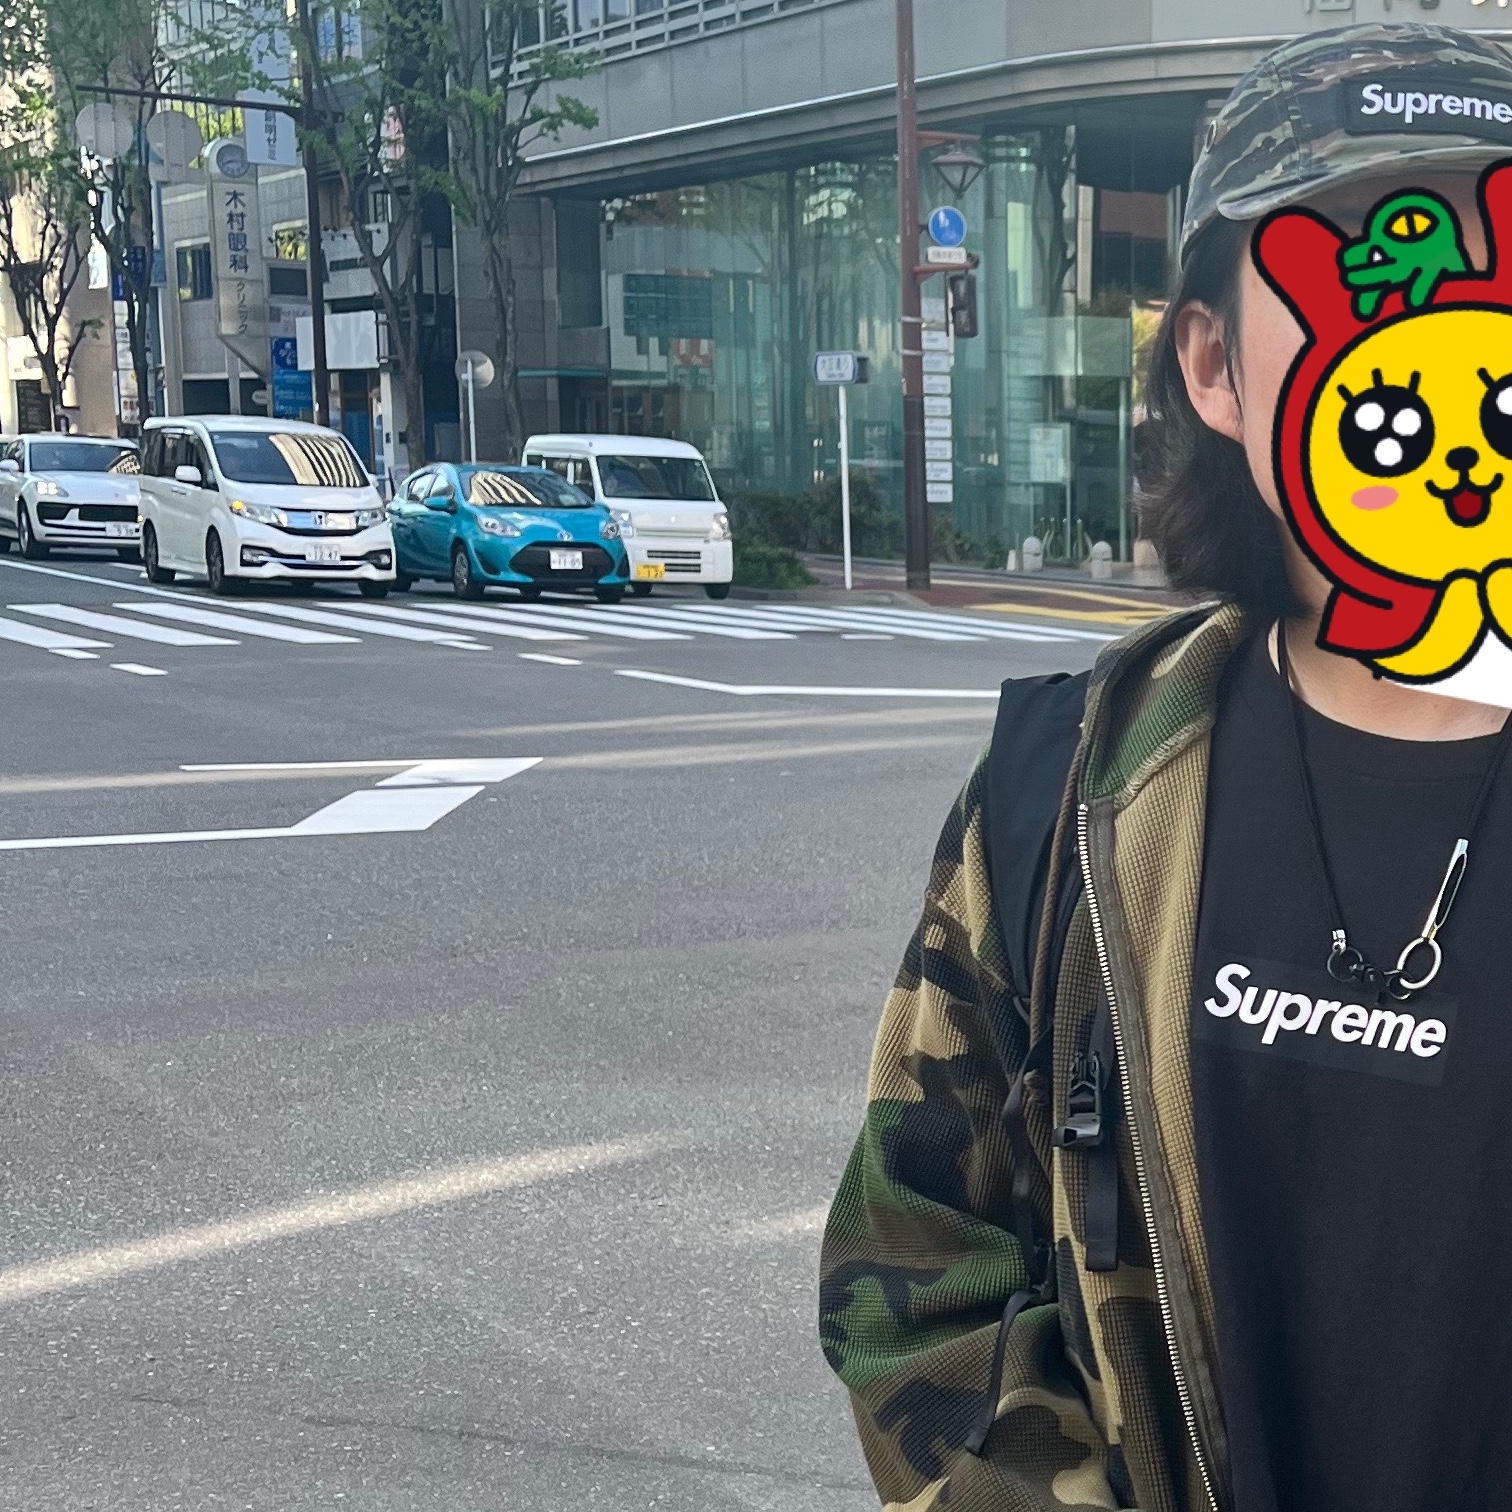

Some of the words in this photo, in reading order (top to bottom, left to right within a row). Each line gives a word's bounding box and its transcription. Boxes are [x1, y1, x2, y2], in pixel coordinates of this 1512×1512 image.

[225, 189, 249, 274] 木村眼科
[1204, 963, 1448, 1058] Supreme
